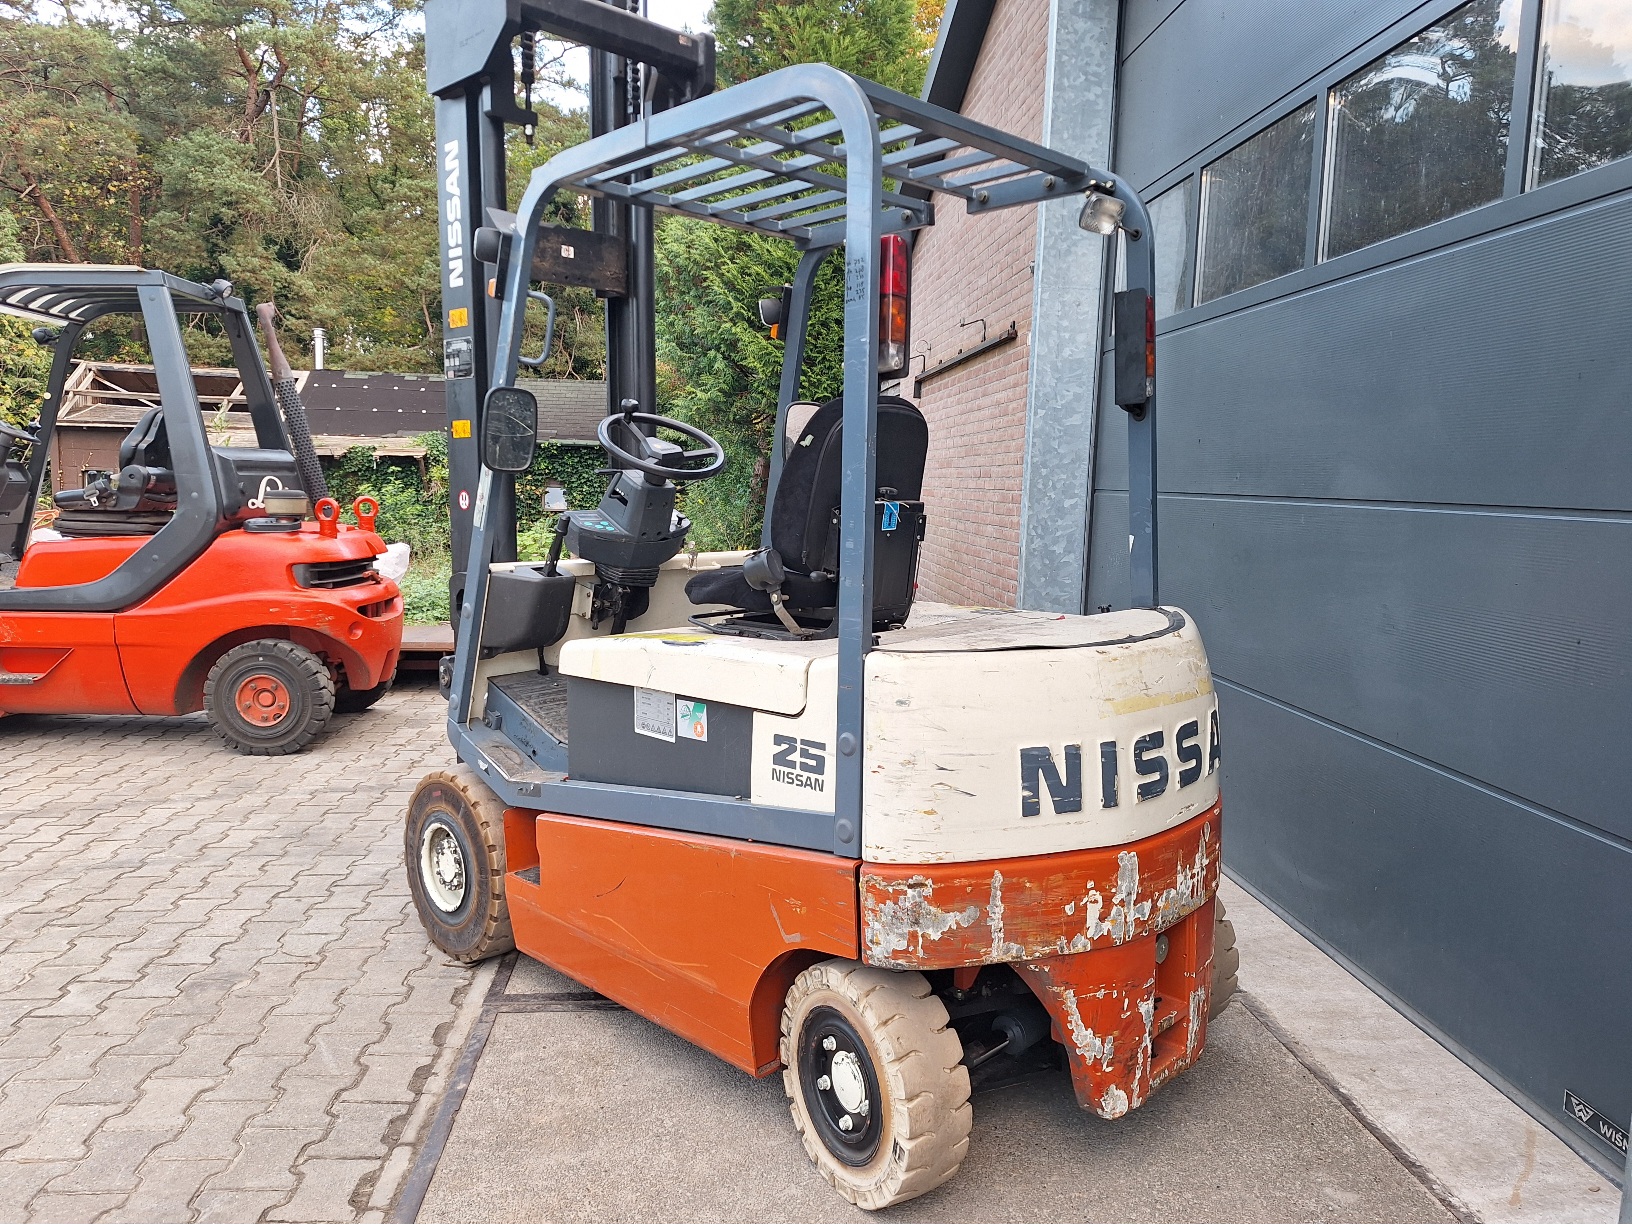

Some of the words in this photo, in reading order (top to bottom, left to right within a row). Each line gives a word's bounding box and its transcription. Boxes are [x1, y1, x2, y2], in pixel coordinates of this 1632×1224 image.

[444, 139, 464, 288] NISSAN
[772, 733, 826, 775] 25
[771, 767, 825, 793] NISSAN
